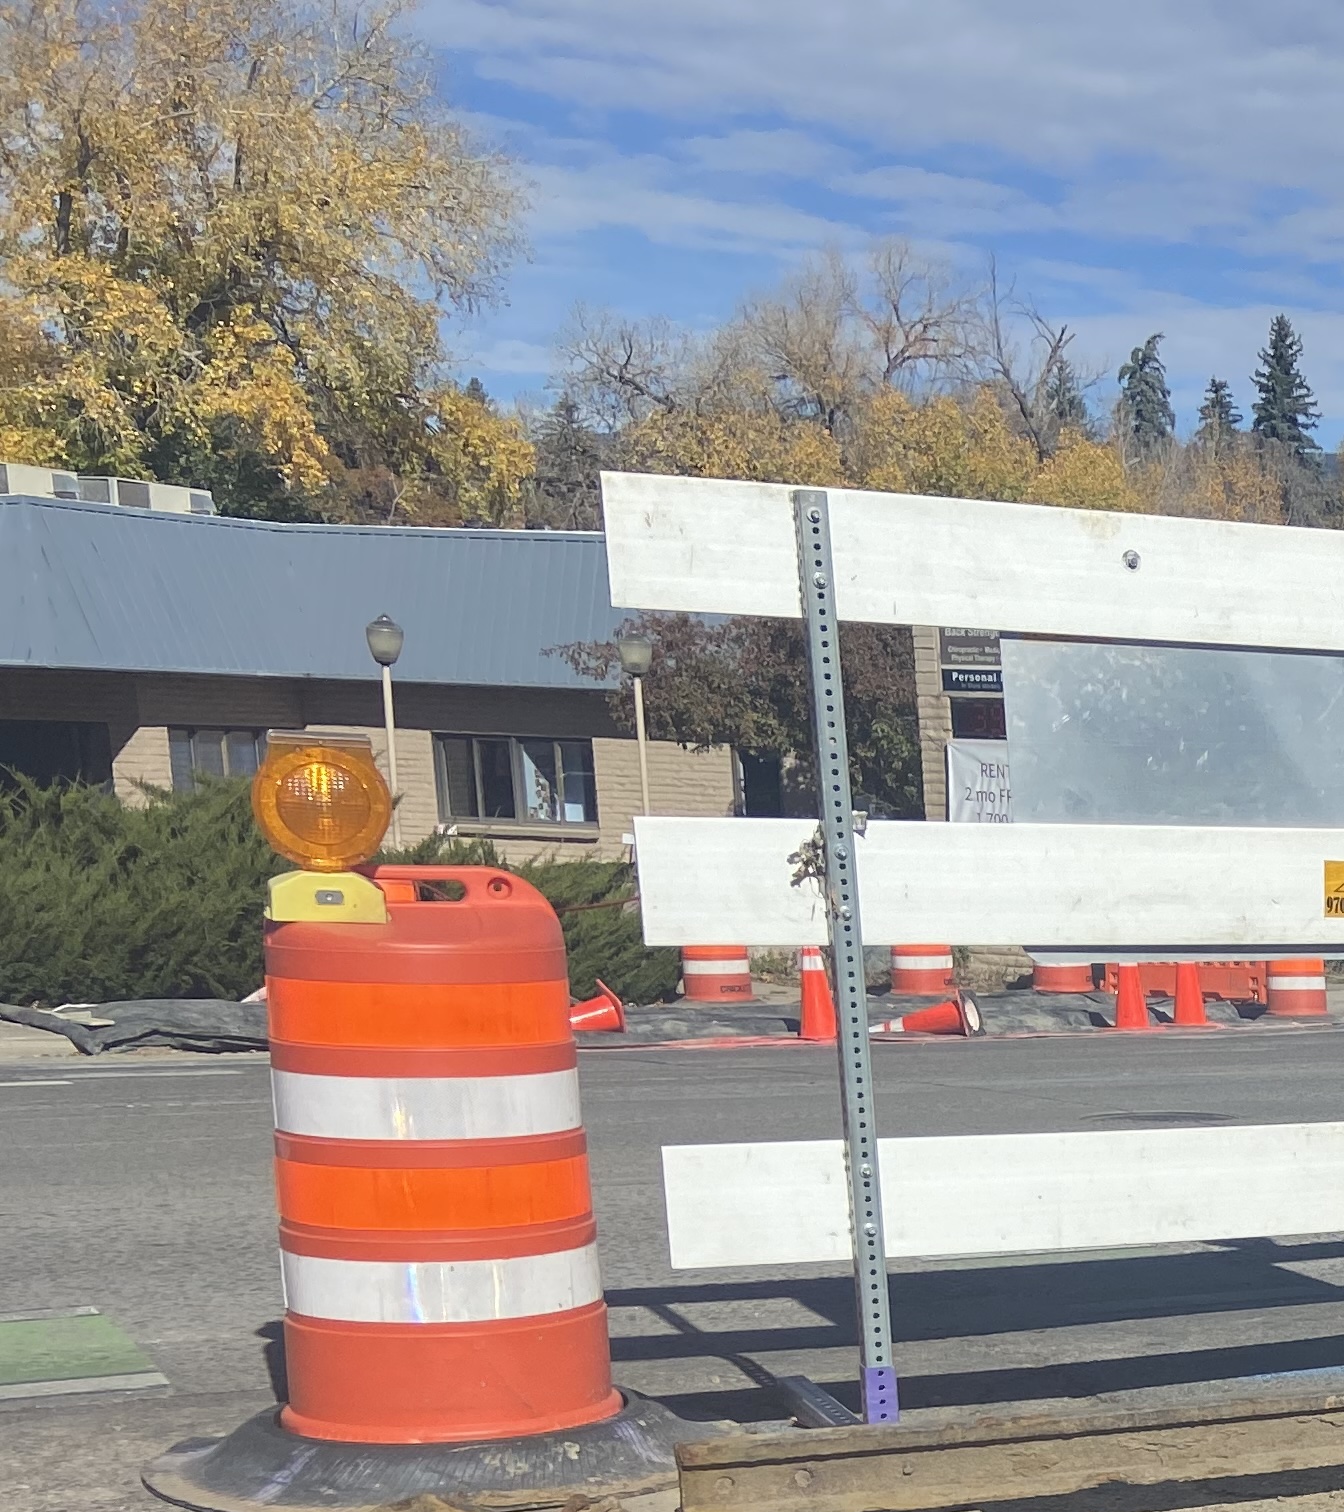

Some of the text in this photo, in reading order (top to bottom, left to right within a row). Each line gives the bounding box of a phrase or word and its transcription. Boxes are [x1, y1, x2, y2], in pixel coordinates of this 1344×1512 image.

[952, 672, 997, 682] Personal
[965, 787, 973, 801] 2
[976, 791, 996, 803] mo
